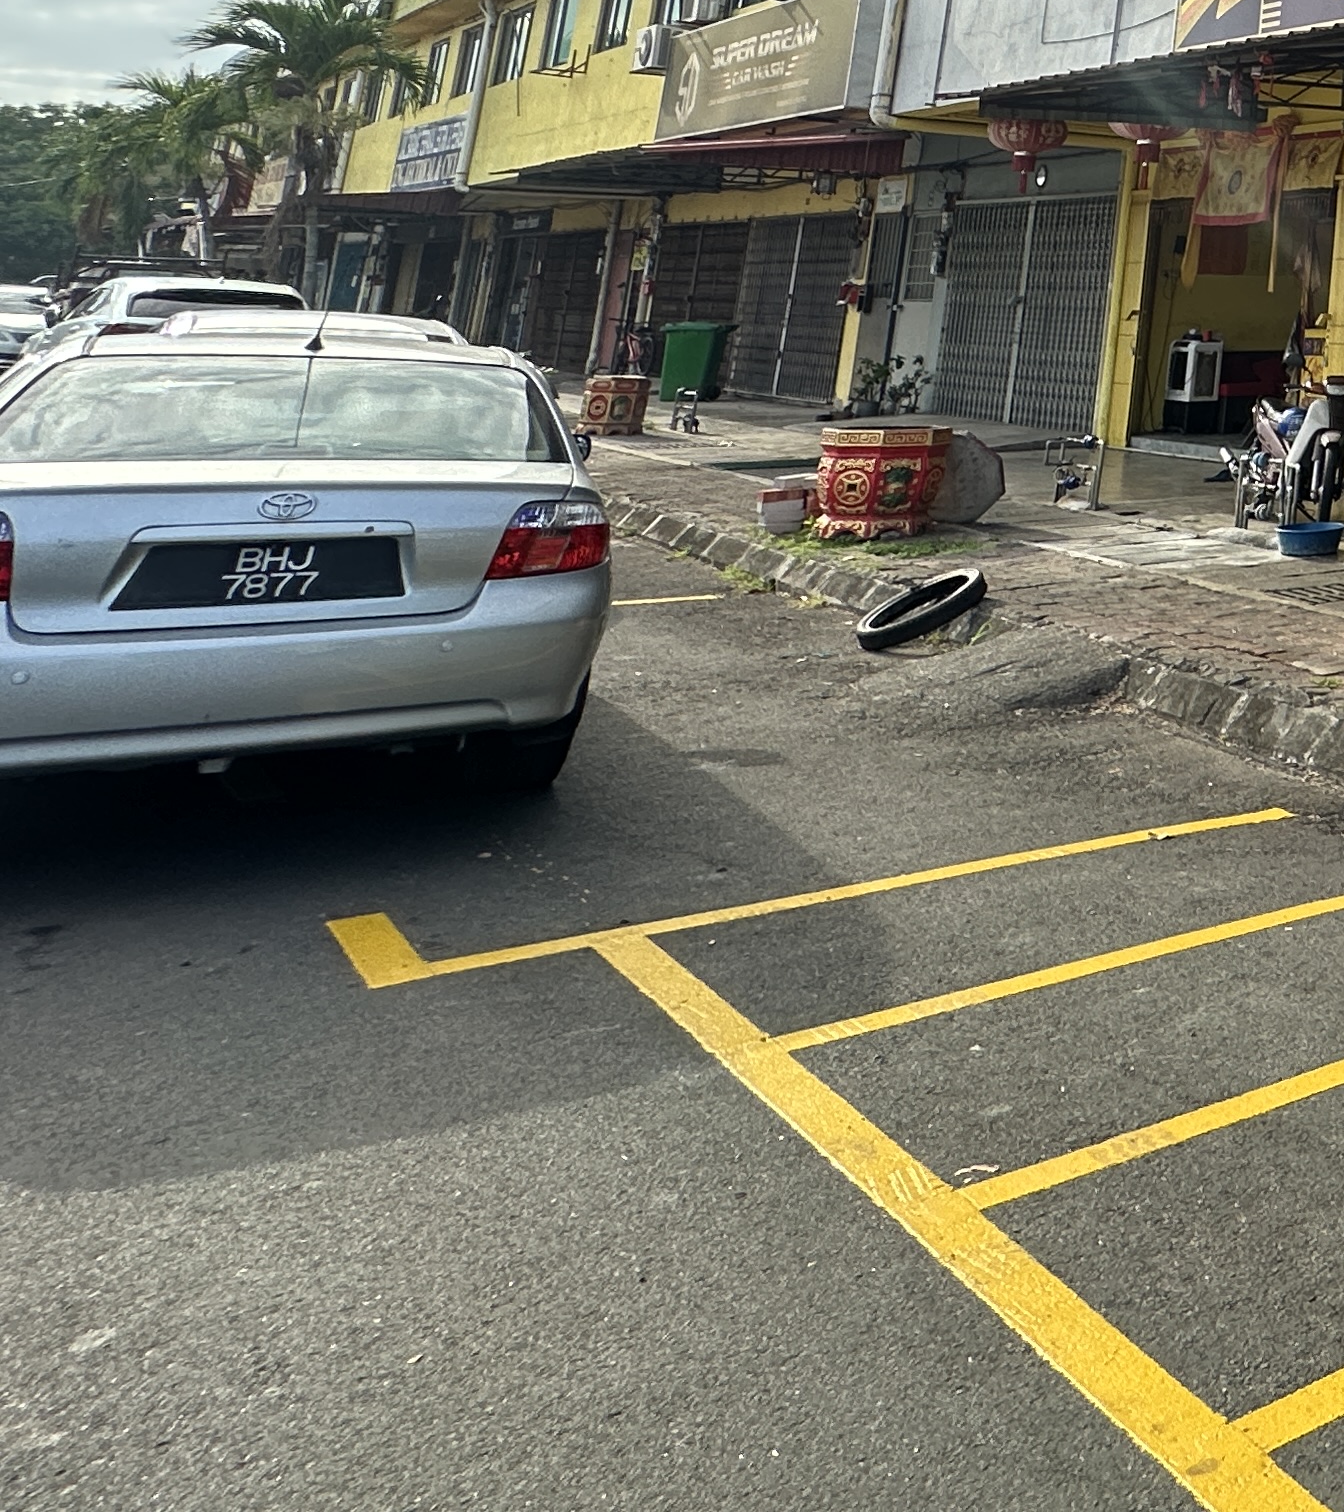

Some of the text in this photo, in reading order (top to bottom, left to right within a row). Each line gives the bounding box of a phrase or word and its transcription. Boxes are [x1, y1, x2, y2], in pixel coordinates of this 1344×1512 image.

[710, 19, 820, 70] SUPER DREAM
[732, 60, 785, 86] CAR WASH
[235, 545, 316, 574] BHJ
[221, 571, 319, 600] 7877
